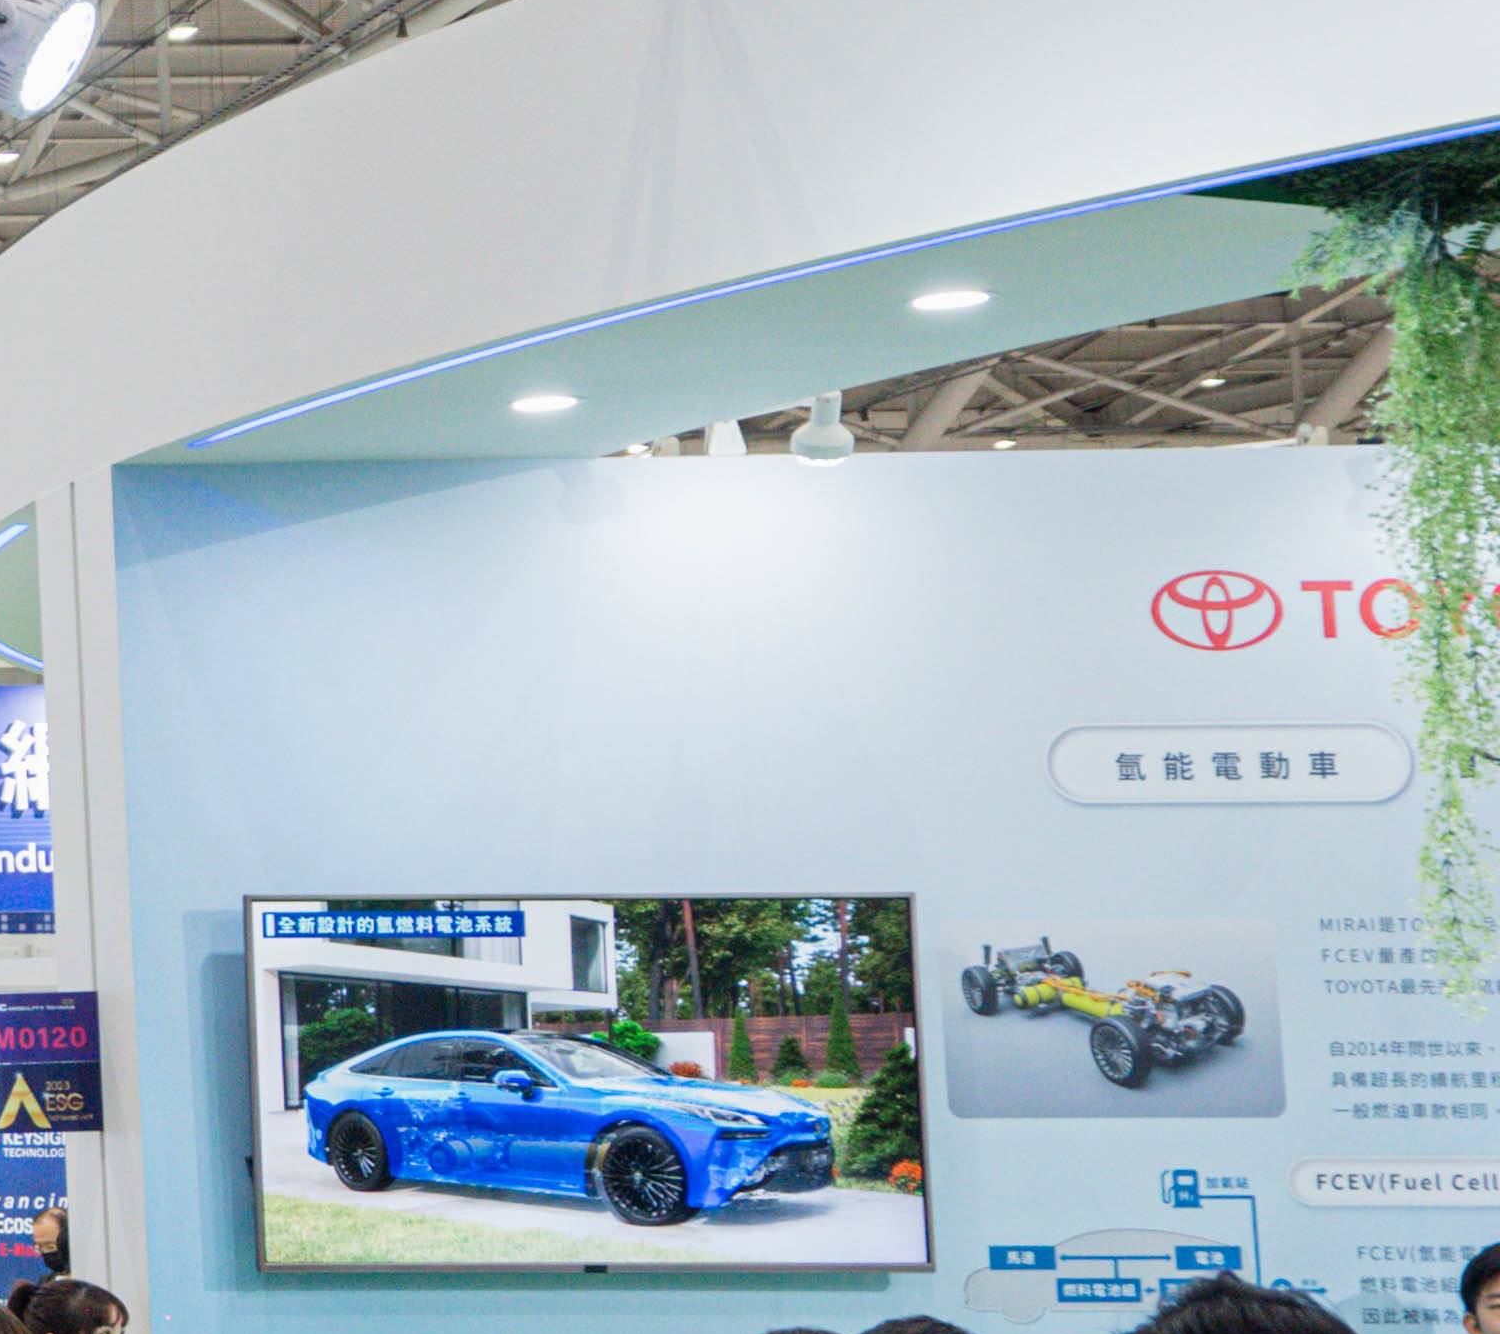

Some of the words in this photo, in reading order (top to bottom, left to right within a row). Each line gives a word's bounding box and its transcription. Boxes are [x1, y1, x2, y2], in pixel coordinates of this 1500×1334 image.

[1115, 751, 1340, 783] 氫能電動車
[275, 911, 514, 937] 全新設計的氫燃料電池系統
[45, 1093, 86, 1112] ESG
[1315, 1172, 1443, 1194] FCEV(Fuel
[1451, 1172, 1500, 1191] Cell
